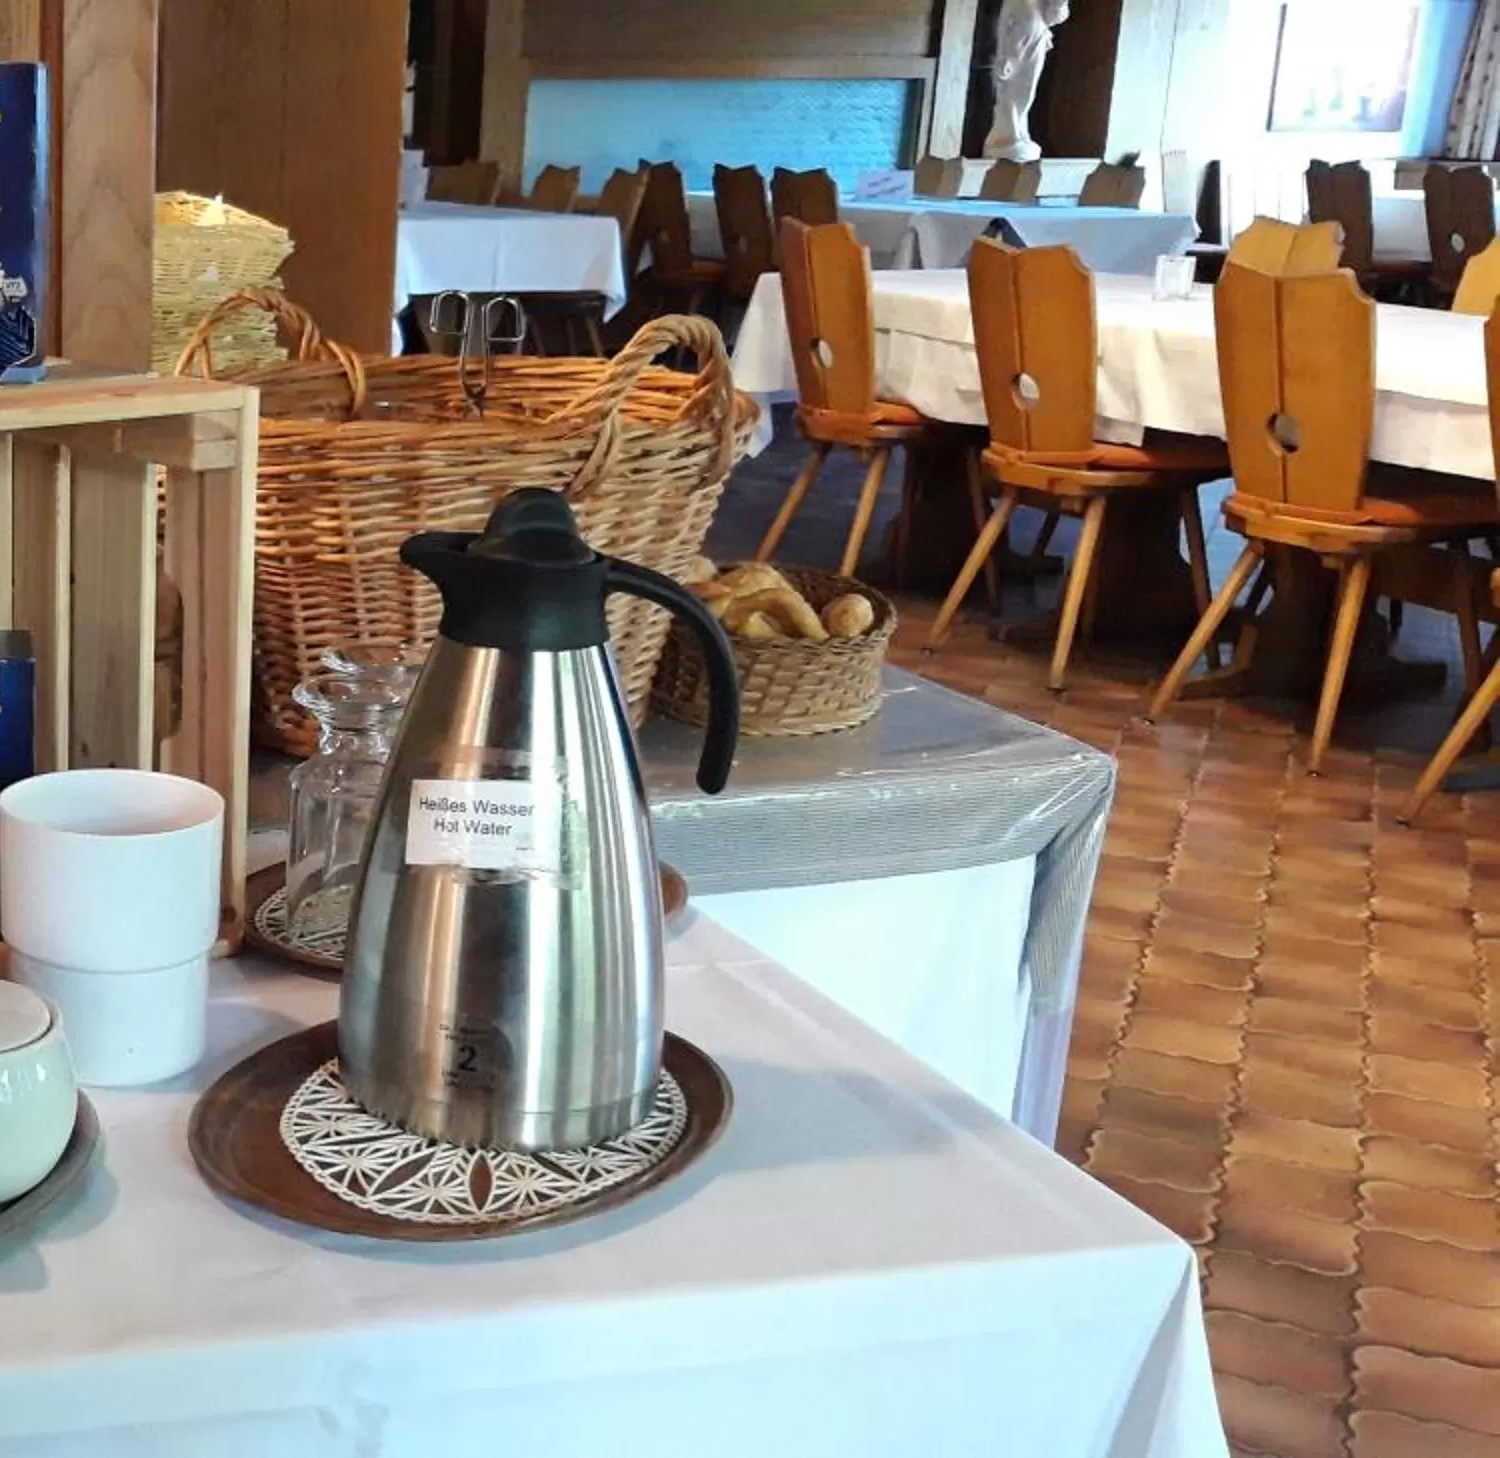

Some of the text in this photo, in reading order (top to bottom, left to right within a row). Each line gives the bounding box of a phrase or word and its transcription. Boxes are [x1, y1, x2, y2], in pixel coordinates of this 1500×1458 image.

[419, 796, 536, 817] Heißes Wasser
[433, 819, 512, 837] Hot Water
[457, 1044, 477, 1072] 2
